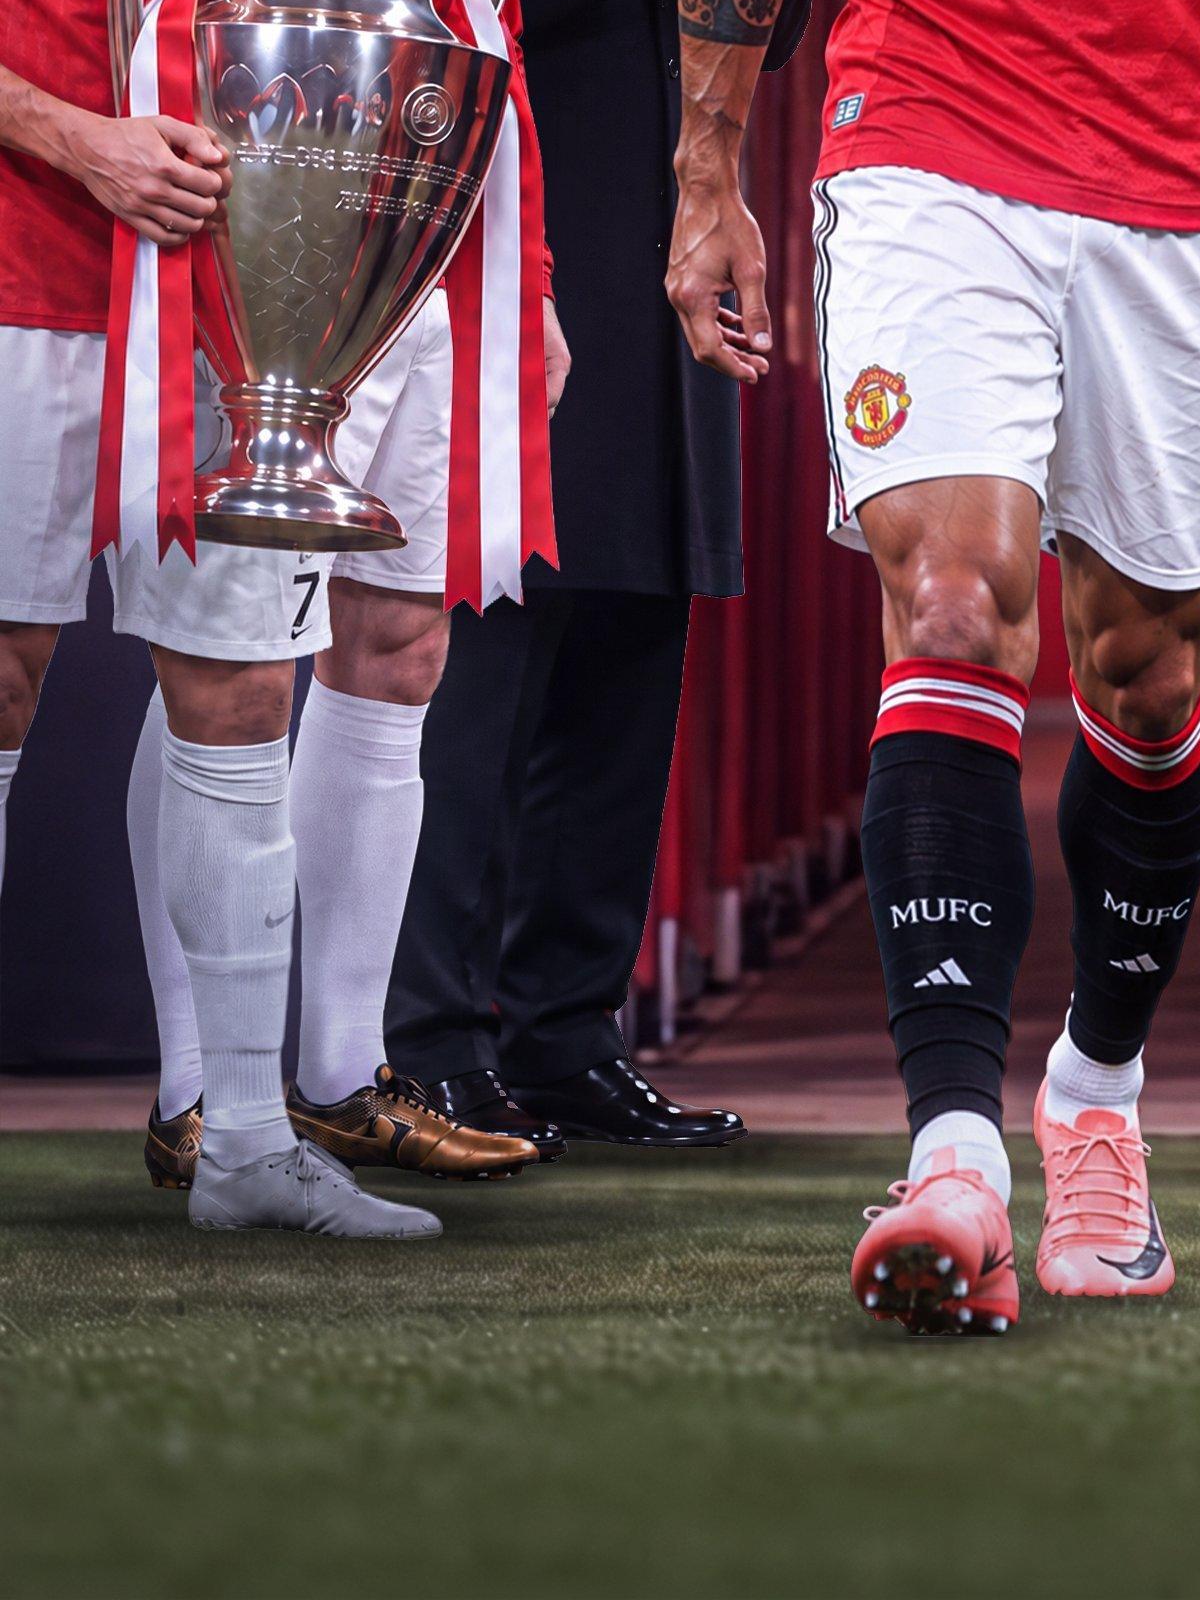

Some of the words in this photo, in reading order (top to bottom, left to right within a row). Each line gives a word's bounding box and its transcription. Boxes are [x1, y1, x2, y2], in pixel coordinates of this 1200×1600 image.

[292, 570, 320, 628] 7
[889, 897, 993, 930] MUFC
[1102, 888, 1191, 927] MUFC
